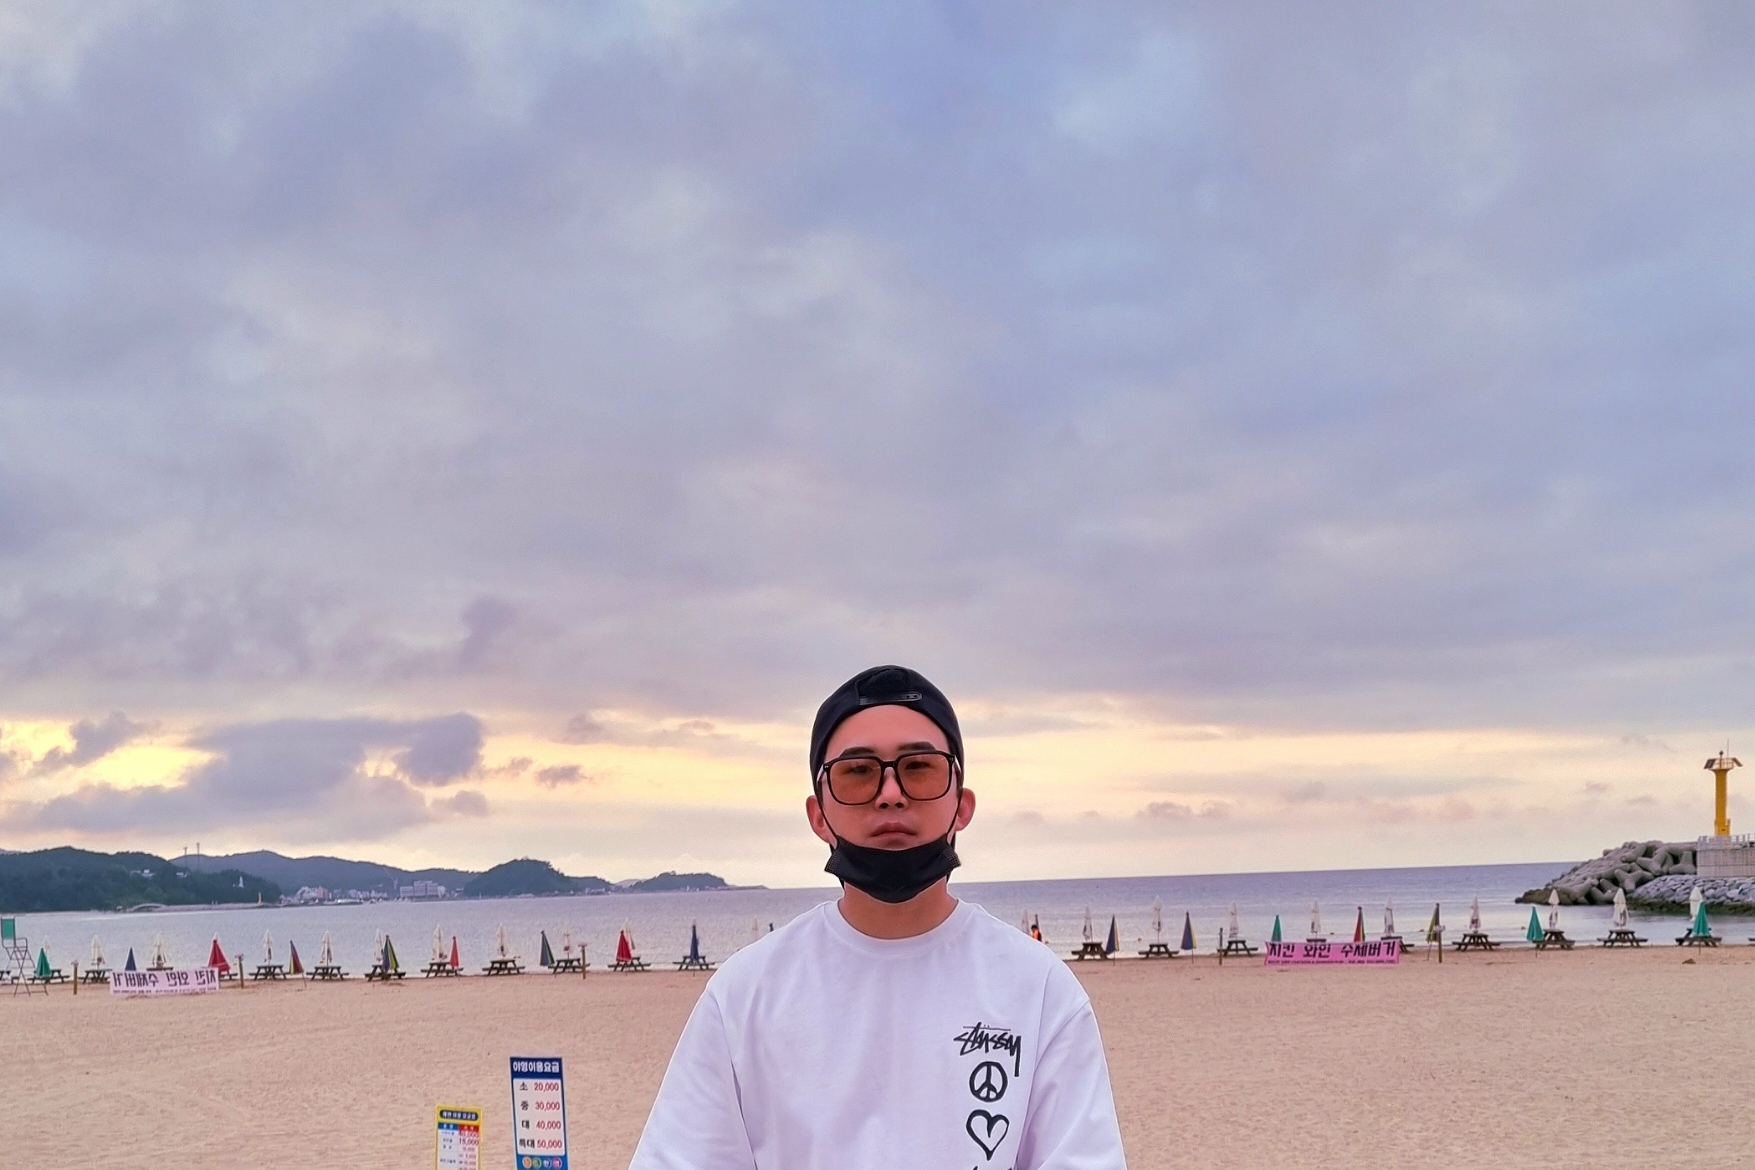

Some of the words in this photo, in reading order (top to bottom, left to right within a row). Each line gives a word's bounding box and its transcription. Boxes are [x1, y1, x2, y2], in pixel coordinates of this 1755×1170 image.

[1303, 942, 1331, 959] 와인
[519, 1081, 528, 1091] 소
[534, 1082, 559, 1092] 20,000
[520, 1101, 529, 1111] 중
[535, 1101, 560, 1112] 30,000
[521, 1120, 530, 1130] 대
[536, 1120, 561, 1131] 40,000
[537, 1139, 562, 1150] 50,000
